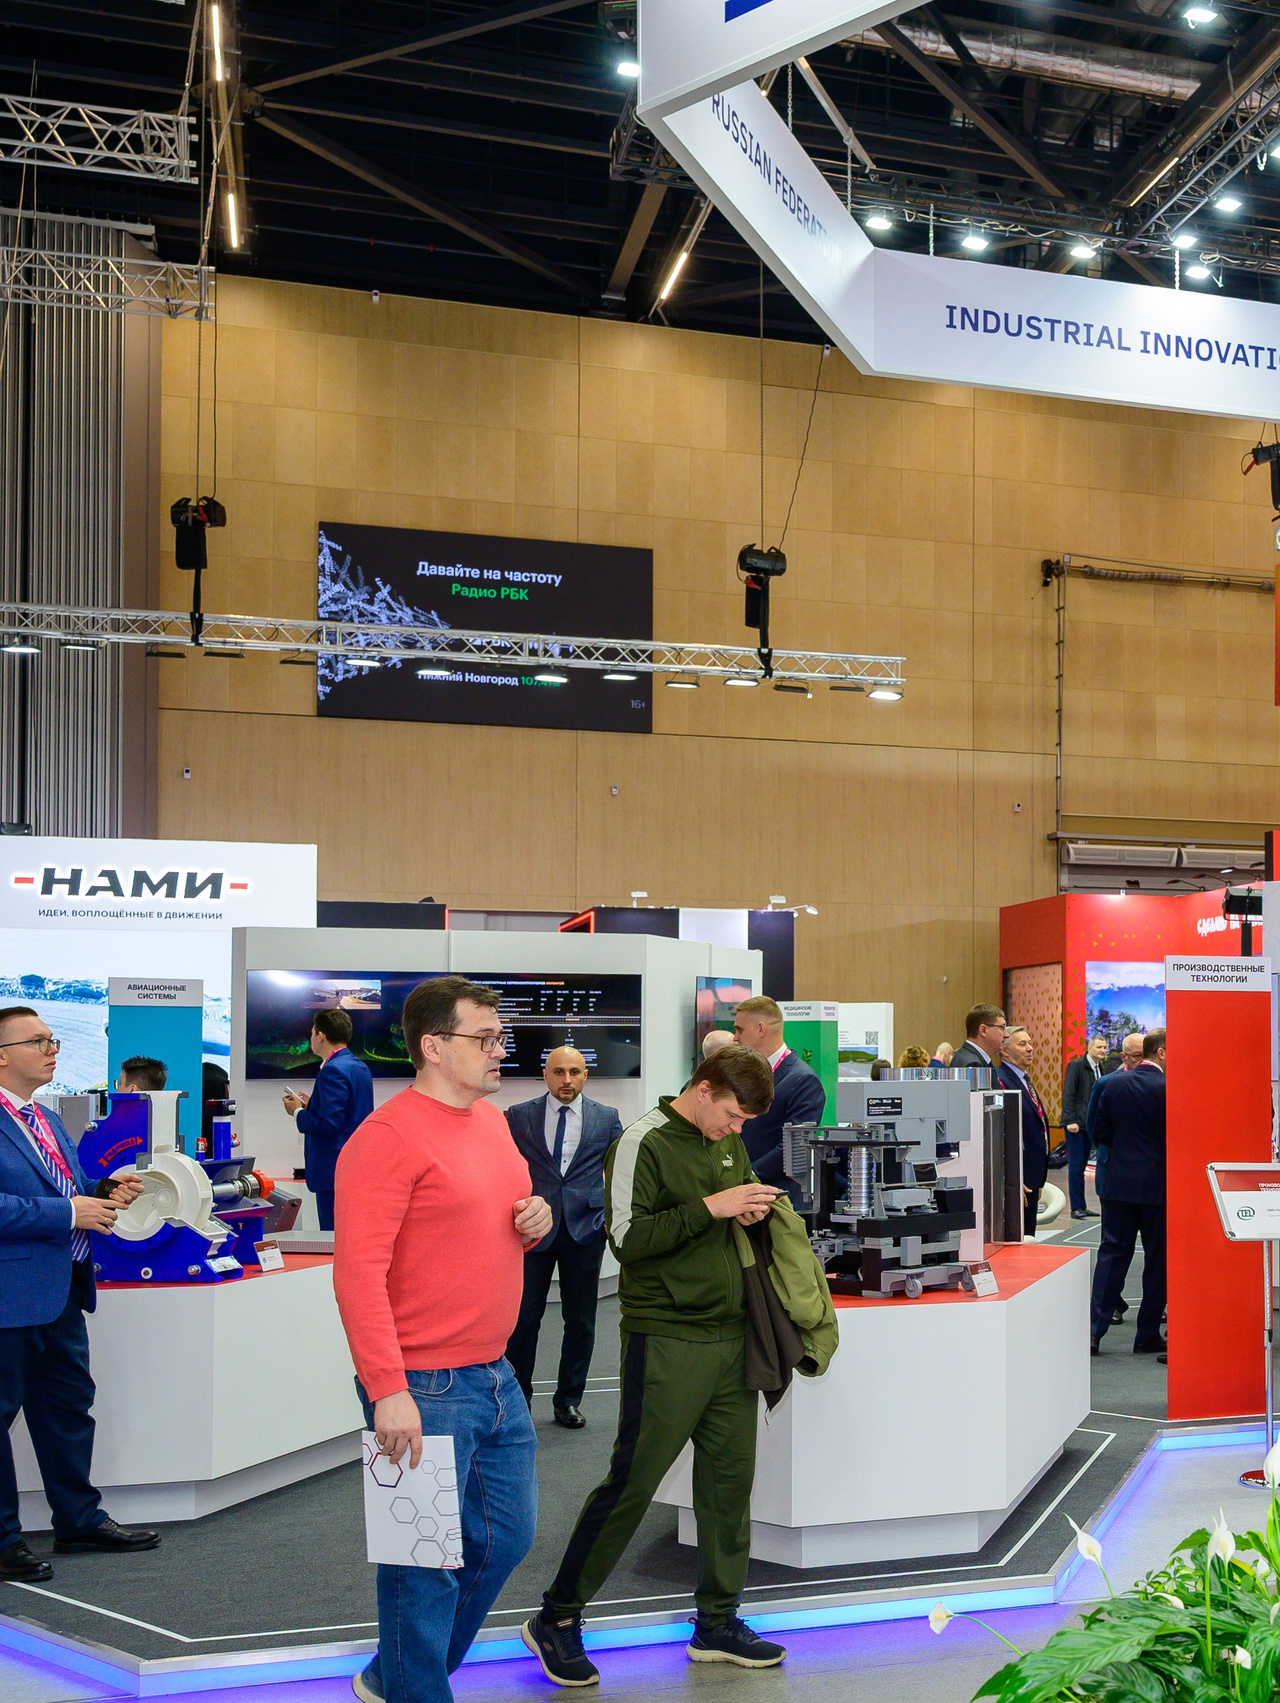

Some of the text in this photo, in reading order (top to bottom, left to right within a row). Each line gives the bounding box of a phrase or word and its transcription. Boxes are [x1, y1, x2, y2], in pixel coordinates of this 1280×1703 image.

[711, 93, 771, 186] RUSSIAN
[945, 304, 1131, 352] INDUSTRIAL
[416, 561, 562, 587] Давайте на частоту
[452, 583, 529, 601] Радио РБК
[465, 673, 519, 686] Новгород
[630, 699, 646, 709] 16+
[40, 868, 224, 899] НАМИ
[38, 909, 69, 918] ИДЕИ,
[72, 909, 155, 919] ВОПЛОЩЁННЫЕ
[165, 911, 223, 920] ДВИЖЕНИИ
[1172, 963, 1265, 973] ПРОИЗВОДСТВЕННЫЕ
[1190, 974, 1248, 983] ТЕХНОЛОГИИ
[127, 983, 187, 992] АВИАЦИОННЫЕ
[137, 992, 177, 1000] СИСТЕМЫ
